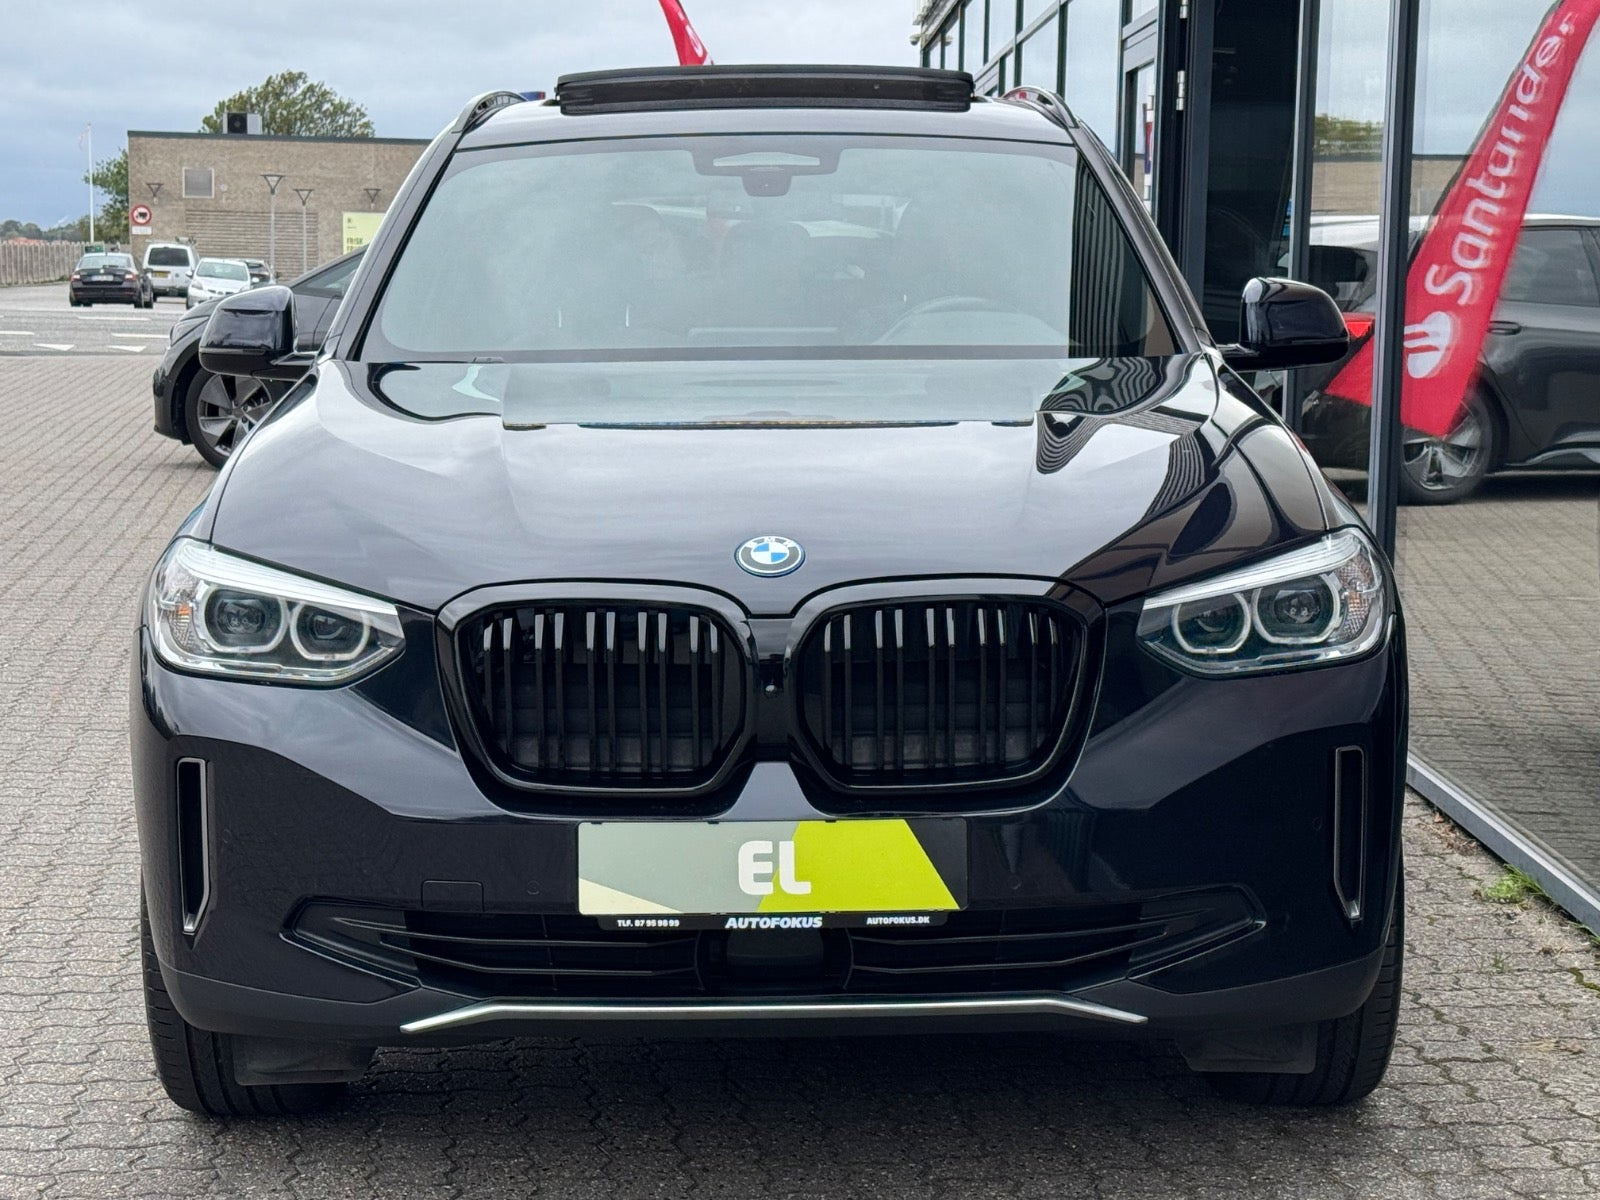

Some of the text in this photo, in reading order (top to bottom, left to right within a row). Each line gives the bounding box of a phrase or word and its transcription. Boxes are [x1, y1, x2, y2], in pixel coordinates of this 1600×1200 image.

[737, 840, 812, 896] EL
[617, 919, 634, 928] TLF.
[725, 916, 823, 929] AUTOFOKUS
[866, 915, 931, 926] AUTOFOKUS.DK
